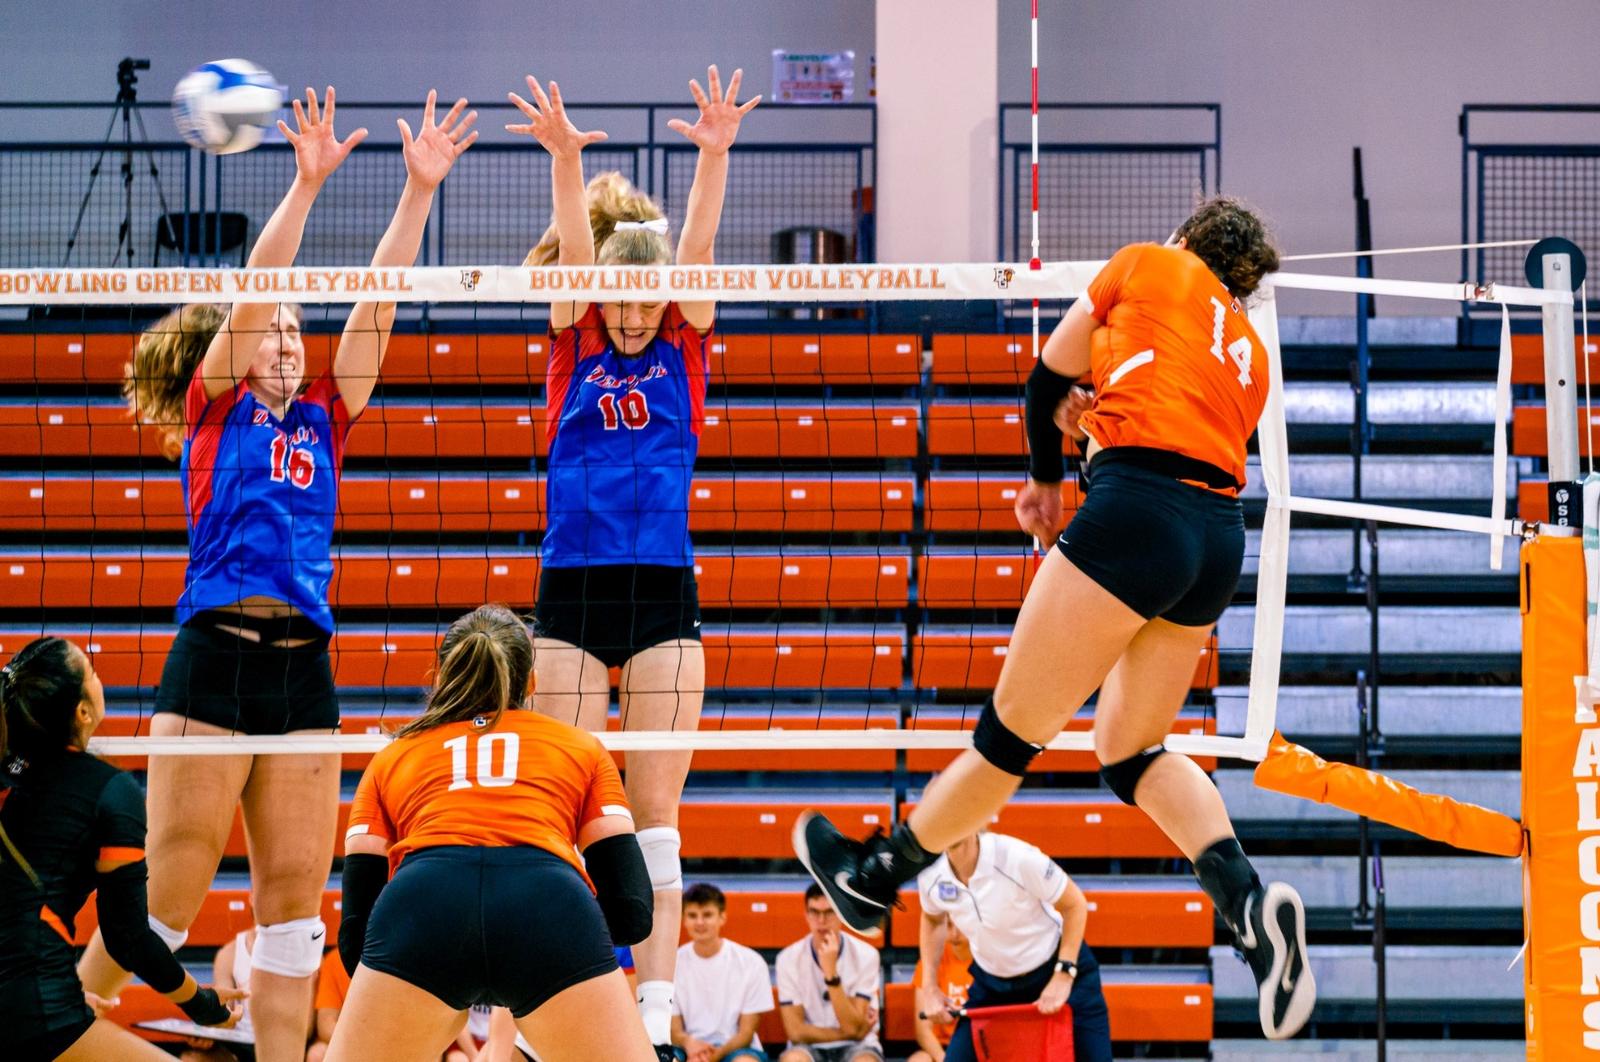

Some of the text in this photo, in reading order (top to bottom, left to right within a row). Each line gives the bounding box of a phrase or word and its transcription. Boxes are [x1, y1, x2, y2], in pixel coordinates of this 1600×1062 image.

[0, 271, 413, 293] BOWLING GREEN VOLLEYBALL
[529, 268, 946, 290] BOWLING GREEN VOLLEYBALL
[1210, 296, 1253, 391] 14
[598, 389, 650, 431] 10
[270, 433, 316, 490] 16
[443, 732, 520, 792] 10
